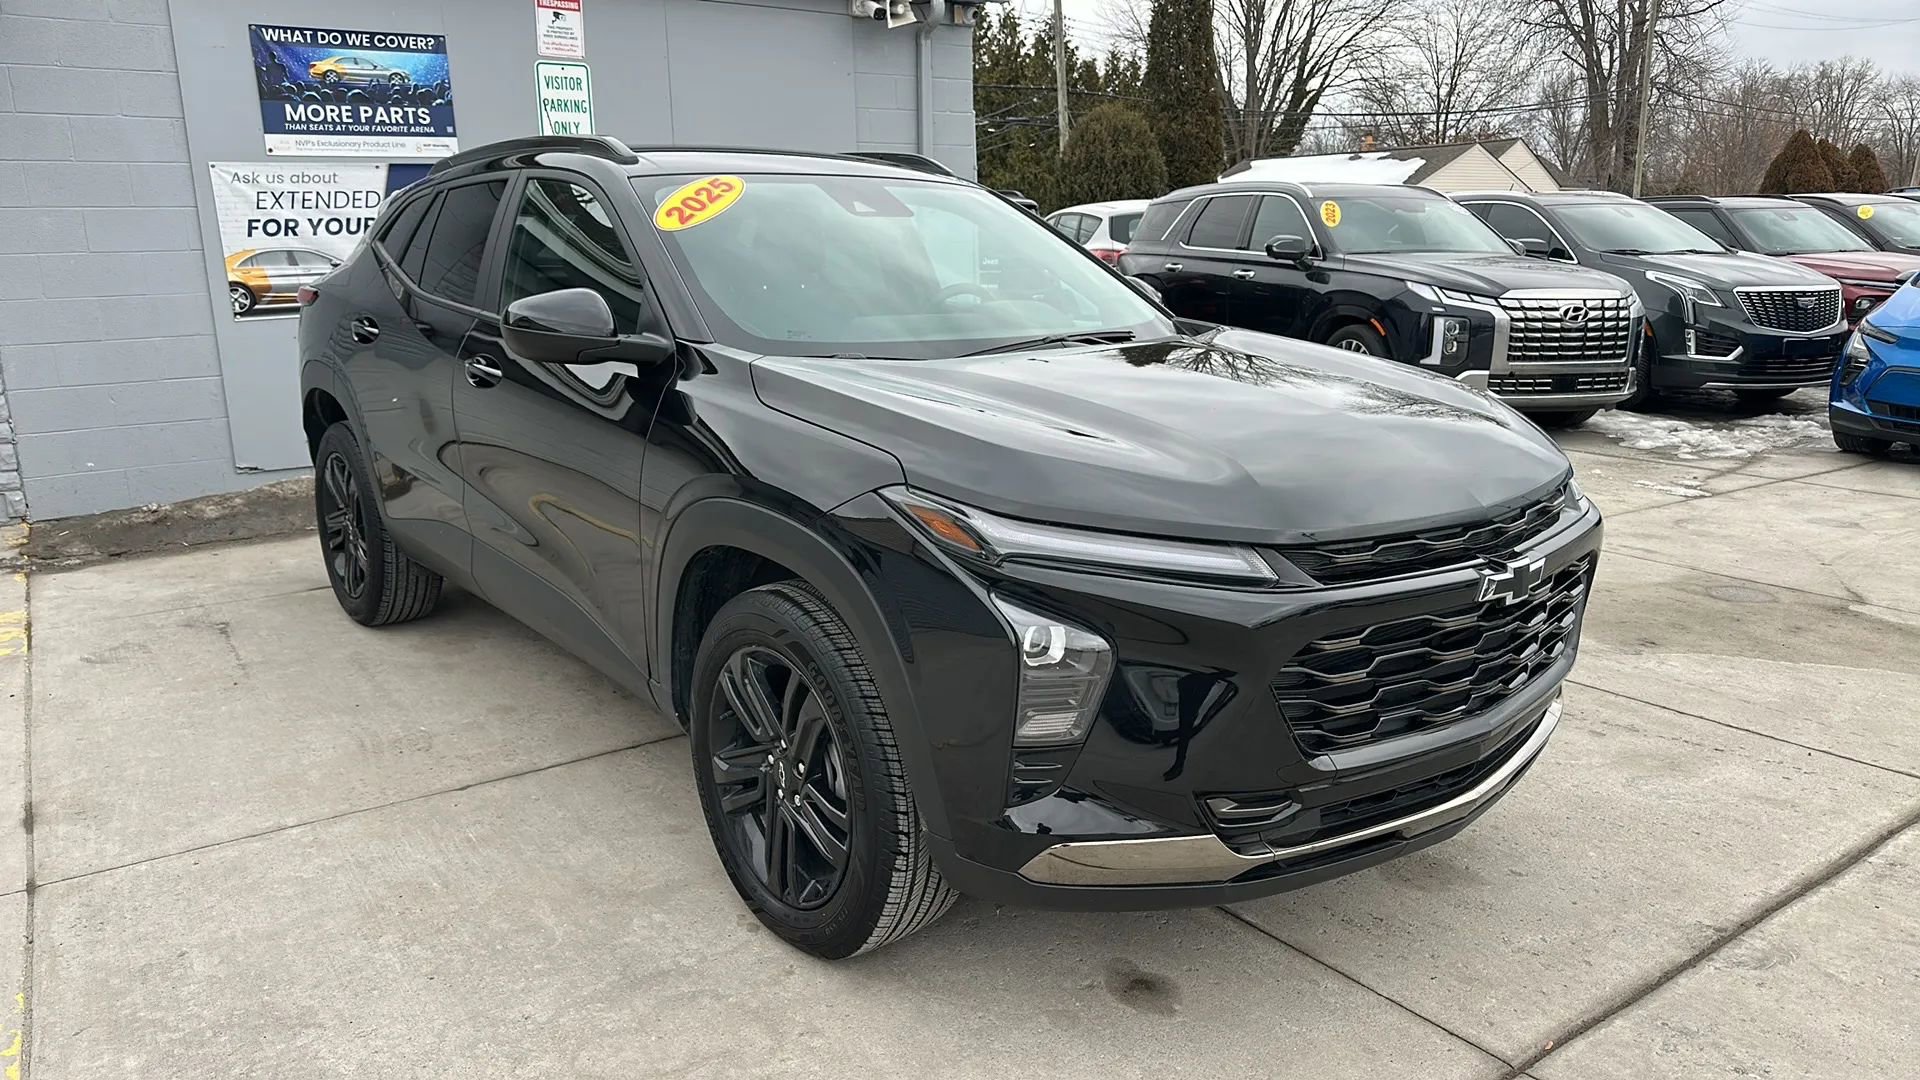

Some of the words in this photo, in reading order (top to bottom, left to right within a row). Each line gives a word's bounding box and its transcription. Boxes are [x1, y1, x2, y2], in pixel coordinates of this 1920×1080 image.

[261, 28, 313, 43] WHAT
[317, 32, 342, 45] DO
[345, 33, 371, 47] WE
[373, 35, 435, 50] COVER?
[544, 75, 583, 91] VISITOR
[284, 103, 354, 123] MORE
[359, 105, 431, 125] PARTS
[543, 98, 588, 114] PARKING
[285, 123, 307, 131] THAN
[309, 123, 334, 132] SEATS
[371, 125, 408, 133] FAVORITE
[554, 121, 581, 135] ONLY
[317, 140, 361, 148] Exclusionary
[231, 171, 260, 185] Ask
[265, 175, 284, 185] us
[289, 171, 339, 185] about
[256, 190, 381, 210] EXTENDED
[665, 178, 735, 226] 2025
[247, 218, 300, 238] FOR
